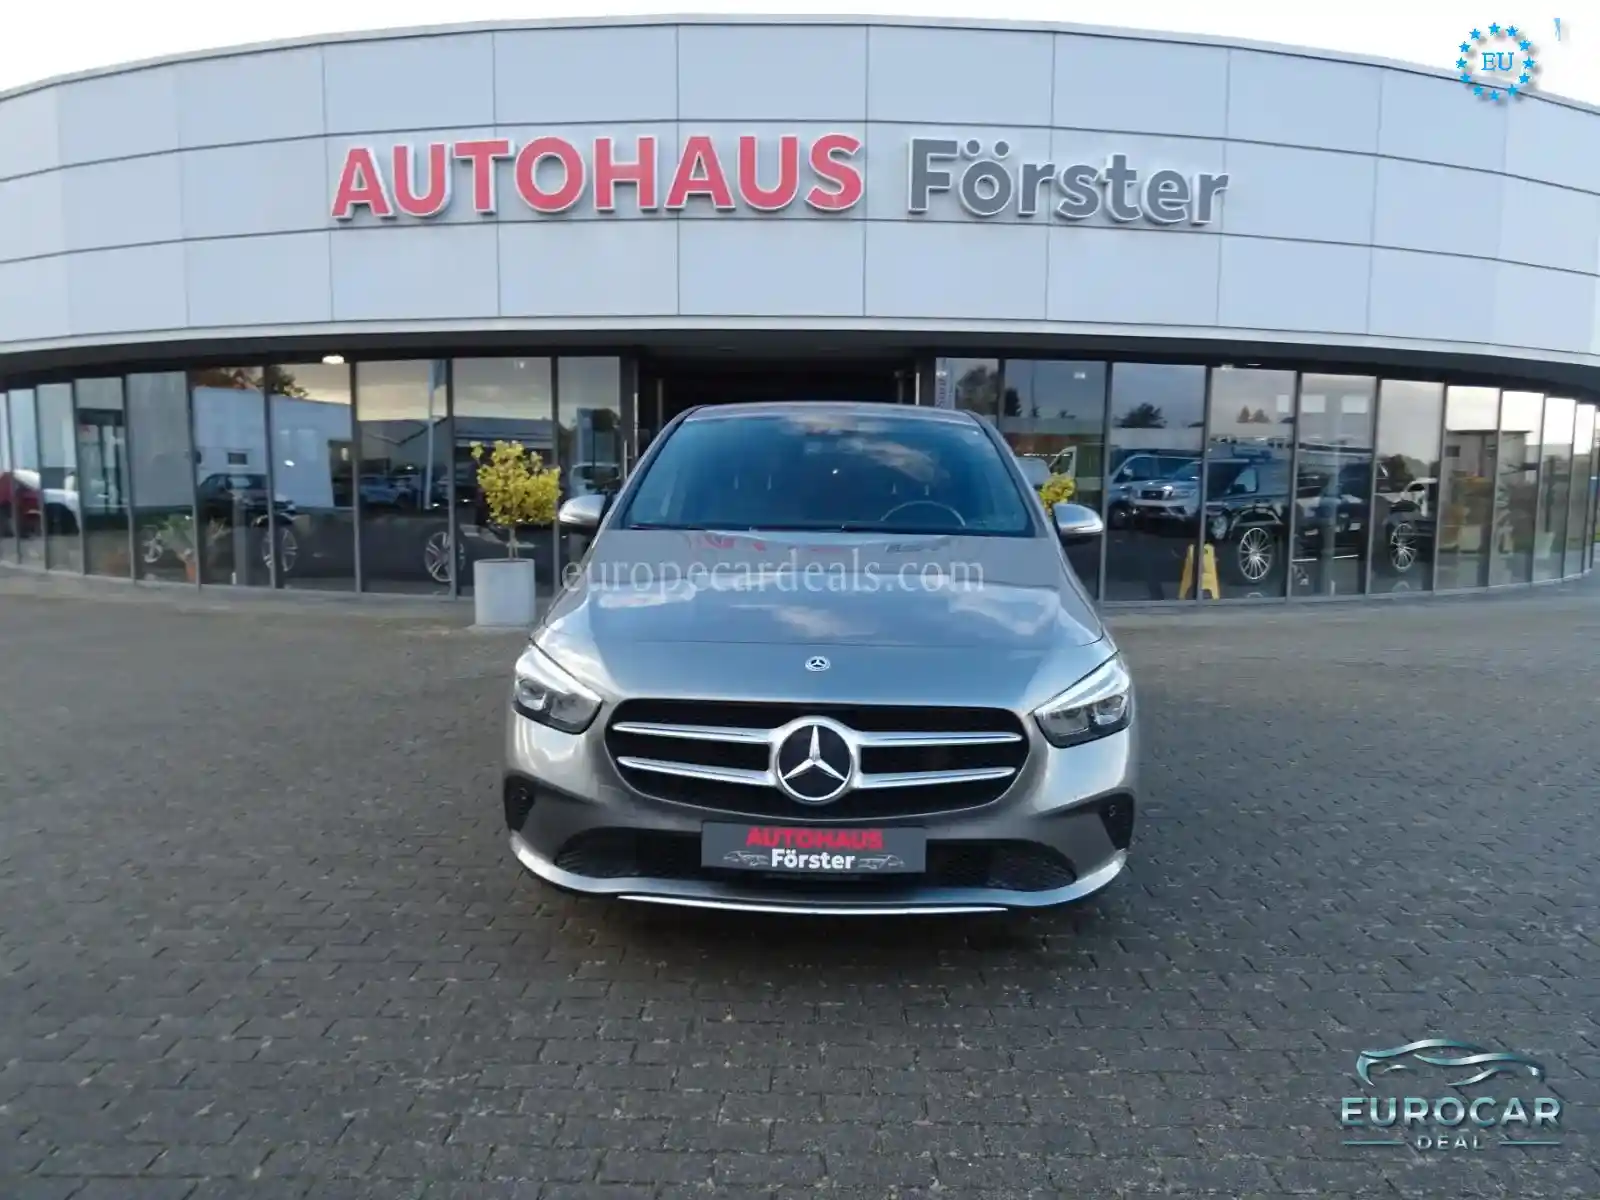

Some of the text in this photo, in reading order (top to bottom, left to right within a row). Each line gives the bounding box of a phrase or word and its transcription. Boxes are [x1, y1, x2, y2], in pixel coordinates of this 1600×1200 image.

[331, 132, 1231, 226] AUTOHAUS Förster
[745, 827, 884, 849] AUTOHAUS
[771, 848, 856, 870] Förster
